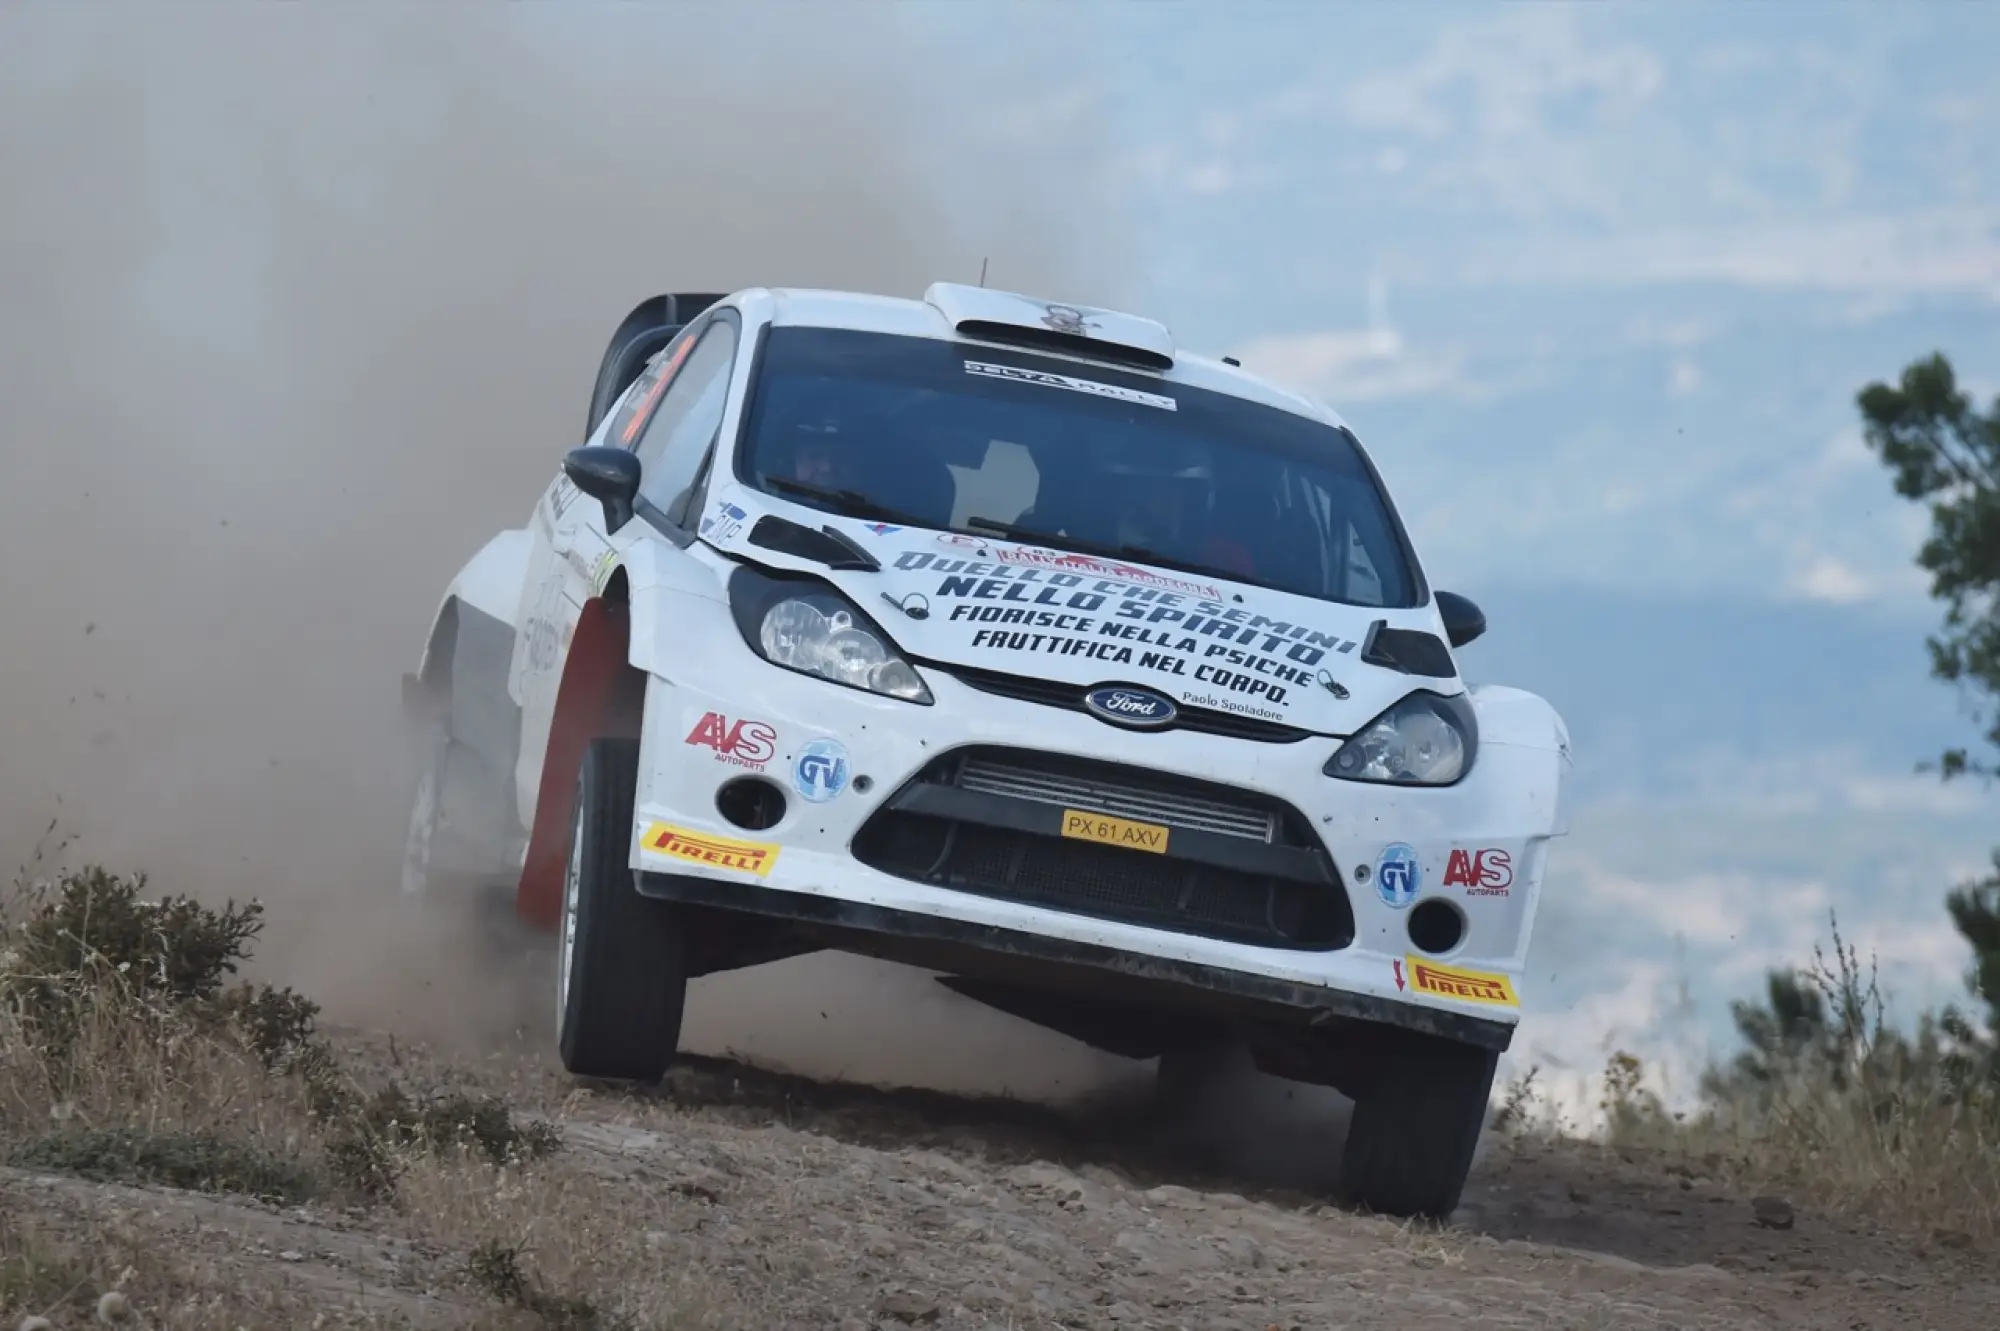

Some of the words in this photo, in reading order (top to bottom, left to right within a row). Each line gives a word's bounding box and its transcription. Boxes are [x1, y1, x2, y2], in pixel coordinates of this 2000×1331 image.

[893, 551, 1083, 587] QUELLO
[1092, 578, 1186, 608] CHE
[1193, 600, 1358, 654] SEMINI
[936, 576, 1107, 611] NELLO
[1115, 600, 1325, 666] SPIRITO
[949, 605, 1095, 632] FIORISCE
[1098, 621, 1198, 653] NELLA
[1204, 643, 1314, 687] PSICHE
[972, 630, 1133, 664] FRUTTIFICA
[1138, 651, 1187, 676] NEL
[1194, 664, 1289, 706] CORPO.
[1106, 692, 1157, 715] Ford
[1182, 691, 1218, 707] Paolo
[1222, 699, 1283, 721] Spoladore
[685, 712, 777, 763] AVS
[714, 753, 766, 773] AUTOPARTS
[654, 831, 767, 871] PIRELLI
[1068, 816, 1093, 836] PX
[1098, 822, 1118, 839] 61
[1123, 827, 1161, 847] AXV
[1443, 848, 1512, 888] AVS
[1466, 888, 1509, 897] AUTOPARTS
[1416, 964, 1508, 1001] PIRELLI
